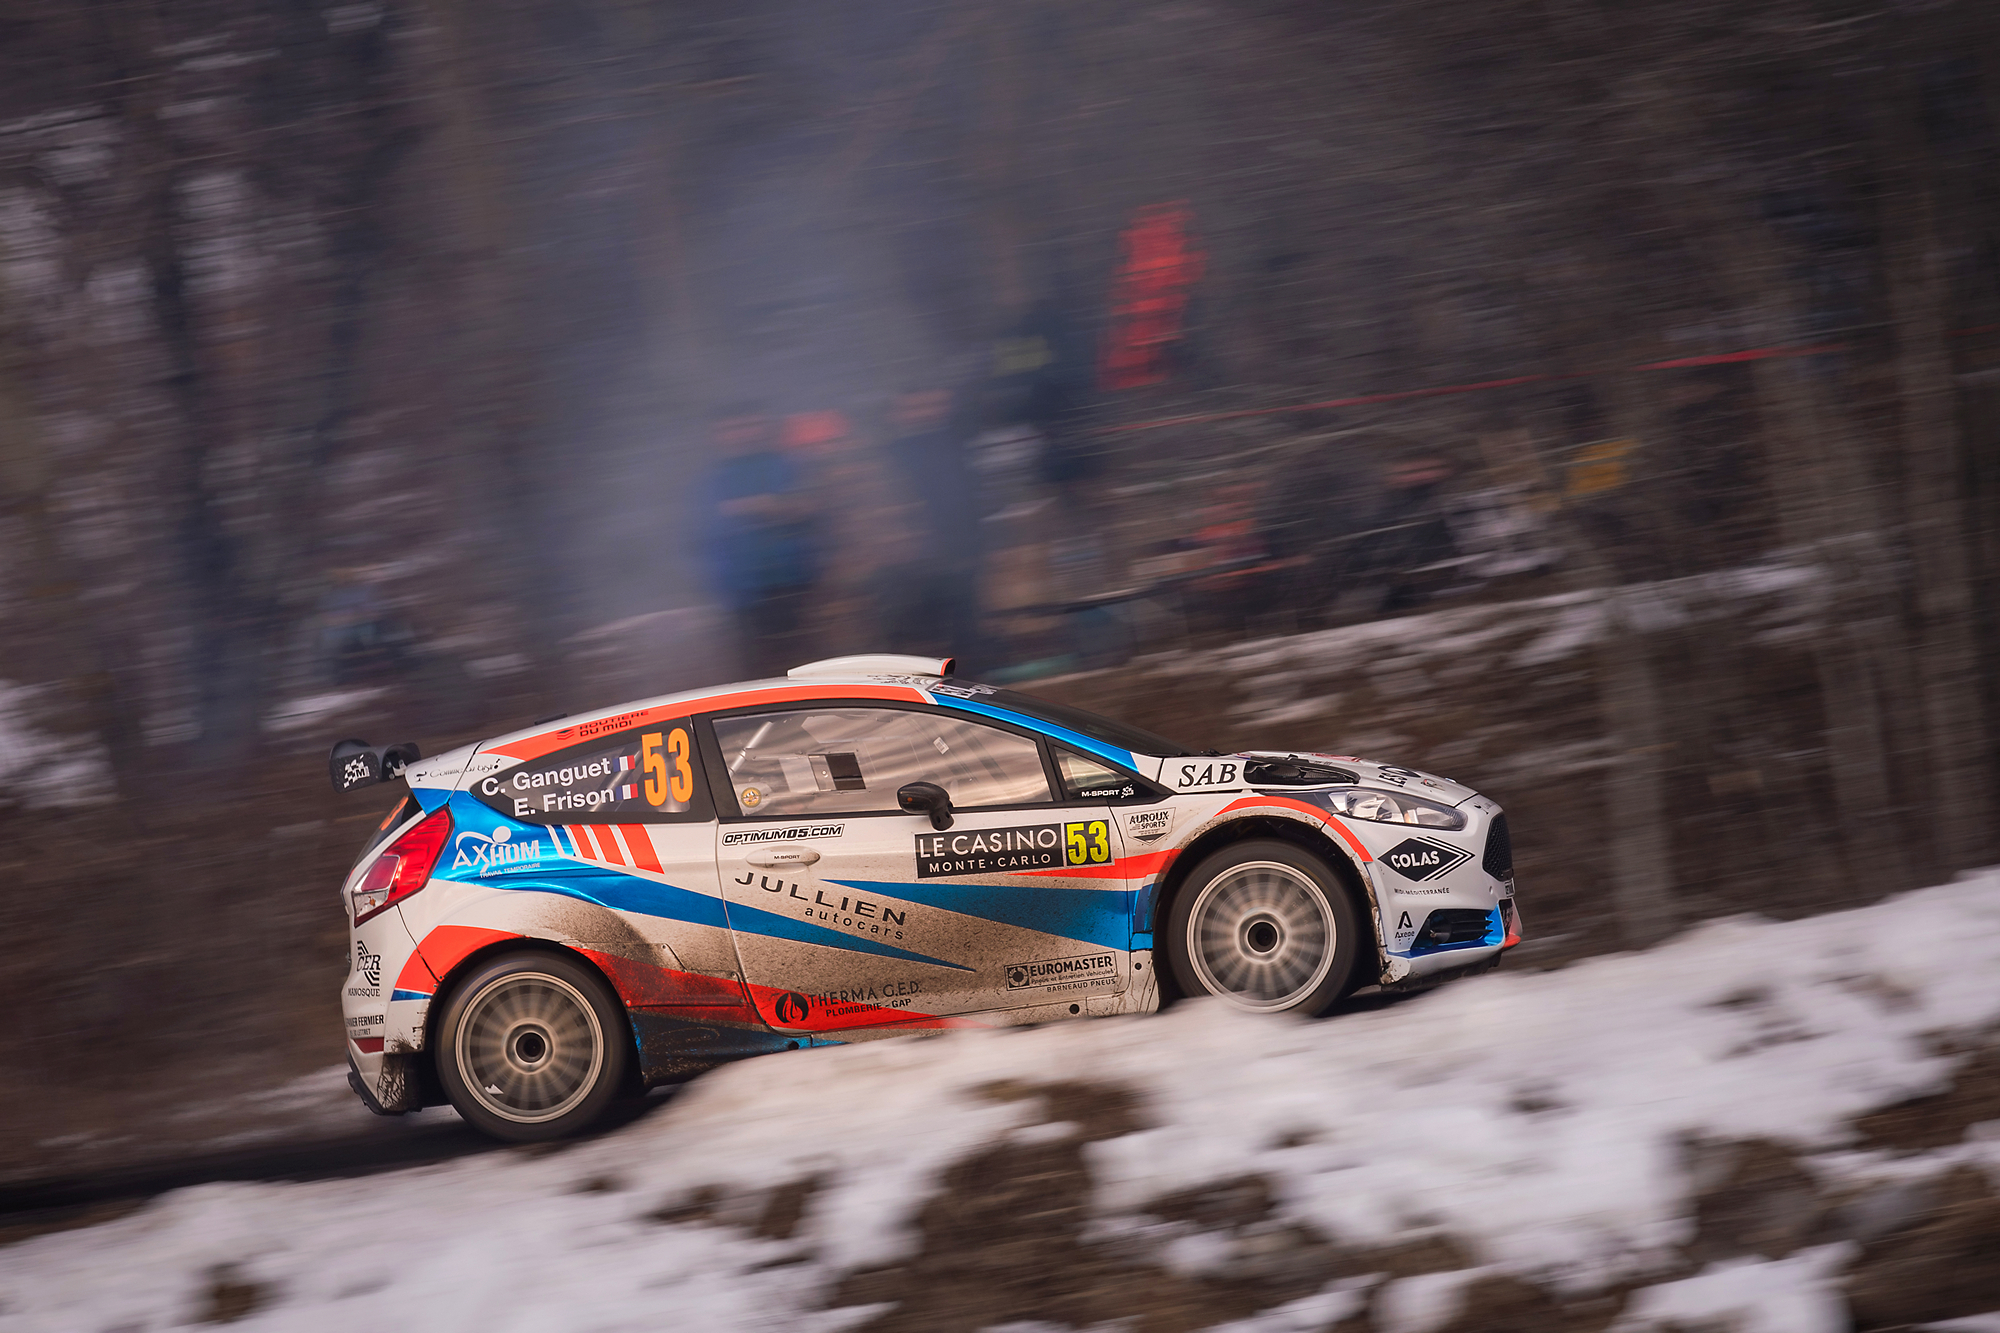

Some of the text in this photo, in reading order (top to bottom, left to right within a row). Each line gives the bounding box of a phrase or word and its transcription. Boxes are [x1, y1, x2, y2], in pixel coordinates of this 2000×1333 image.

[580, 720, 632, 737] DU MIDI
[481, 777, 506, 796] C.
[512, 757, 612, 790] Ganguet
[641, 728, 693, 807] 53
[1178, 763, 1237, 788] SAB
[513, 788, 615, 817] E. Frison
[1081, 789, 1120, 798] M-SPORT
[1129, 811, 1169, 824] AUROUX
[1141, 820, 1166, 830] SPORTS
[724, 825, 843, 844] OPTIMUM05.COM
[919, 828, 1057, 858] LE CASINO
[1067, 821, 1108, 865] 53
[504, 862, 541, 874] TEMPORAIRE
[1390, 850, 1440, 869] COLAS
[735, 872, 906, 926] JULLIEN
[805, 907, 904, 940] autocars
[356, 954, 381, 972] CER
[1030, 955, 1113, 977] EUROMASTER
[348, 988, 380, 998] MANOSQUE
[808, 981, 922, 1008] THERMA G.E.D.
[1047, 978, 1116, 992] BARNEAUD PNEUS
[825, 1003, 882, 1017] PLOMBERIE
[892, 998, 912, 1009] GAP
[358, 1014, 384, 1026] FERMIER
